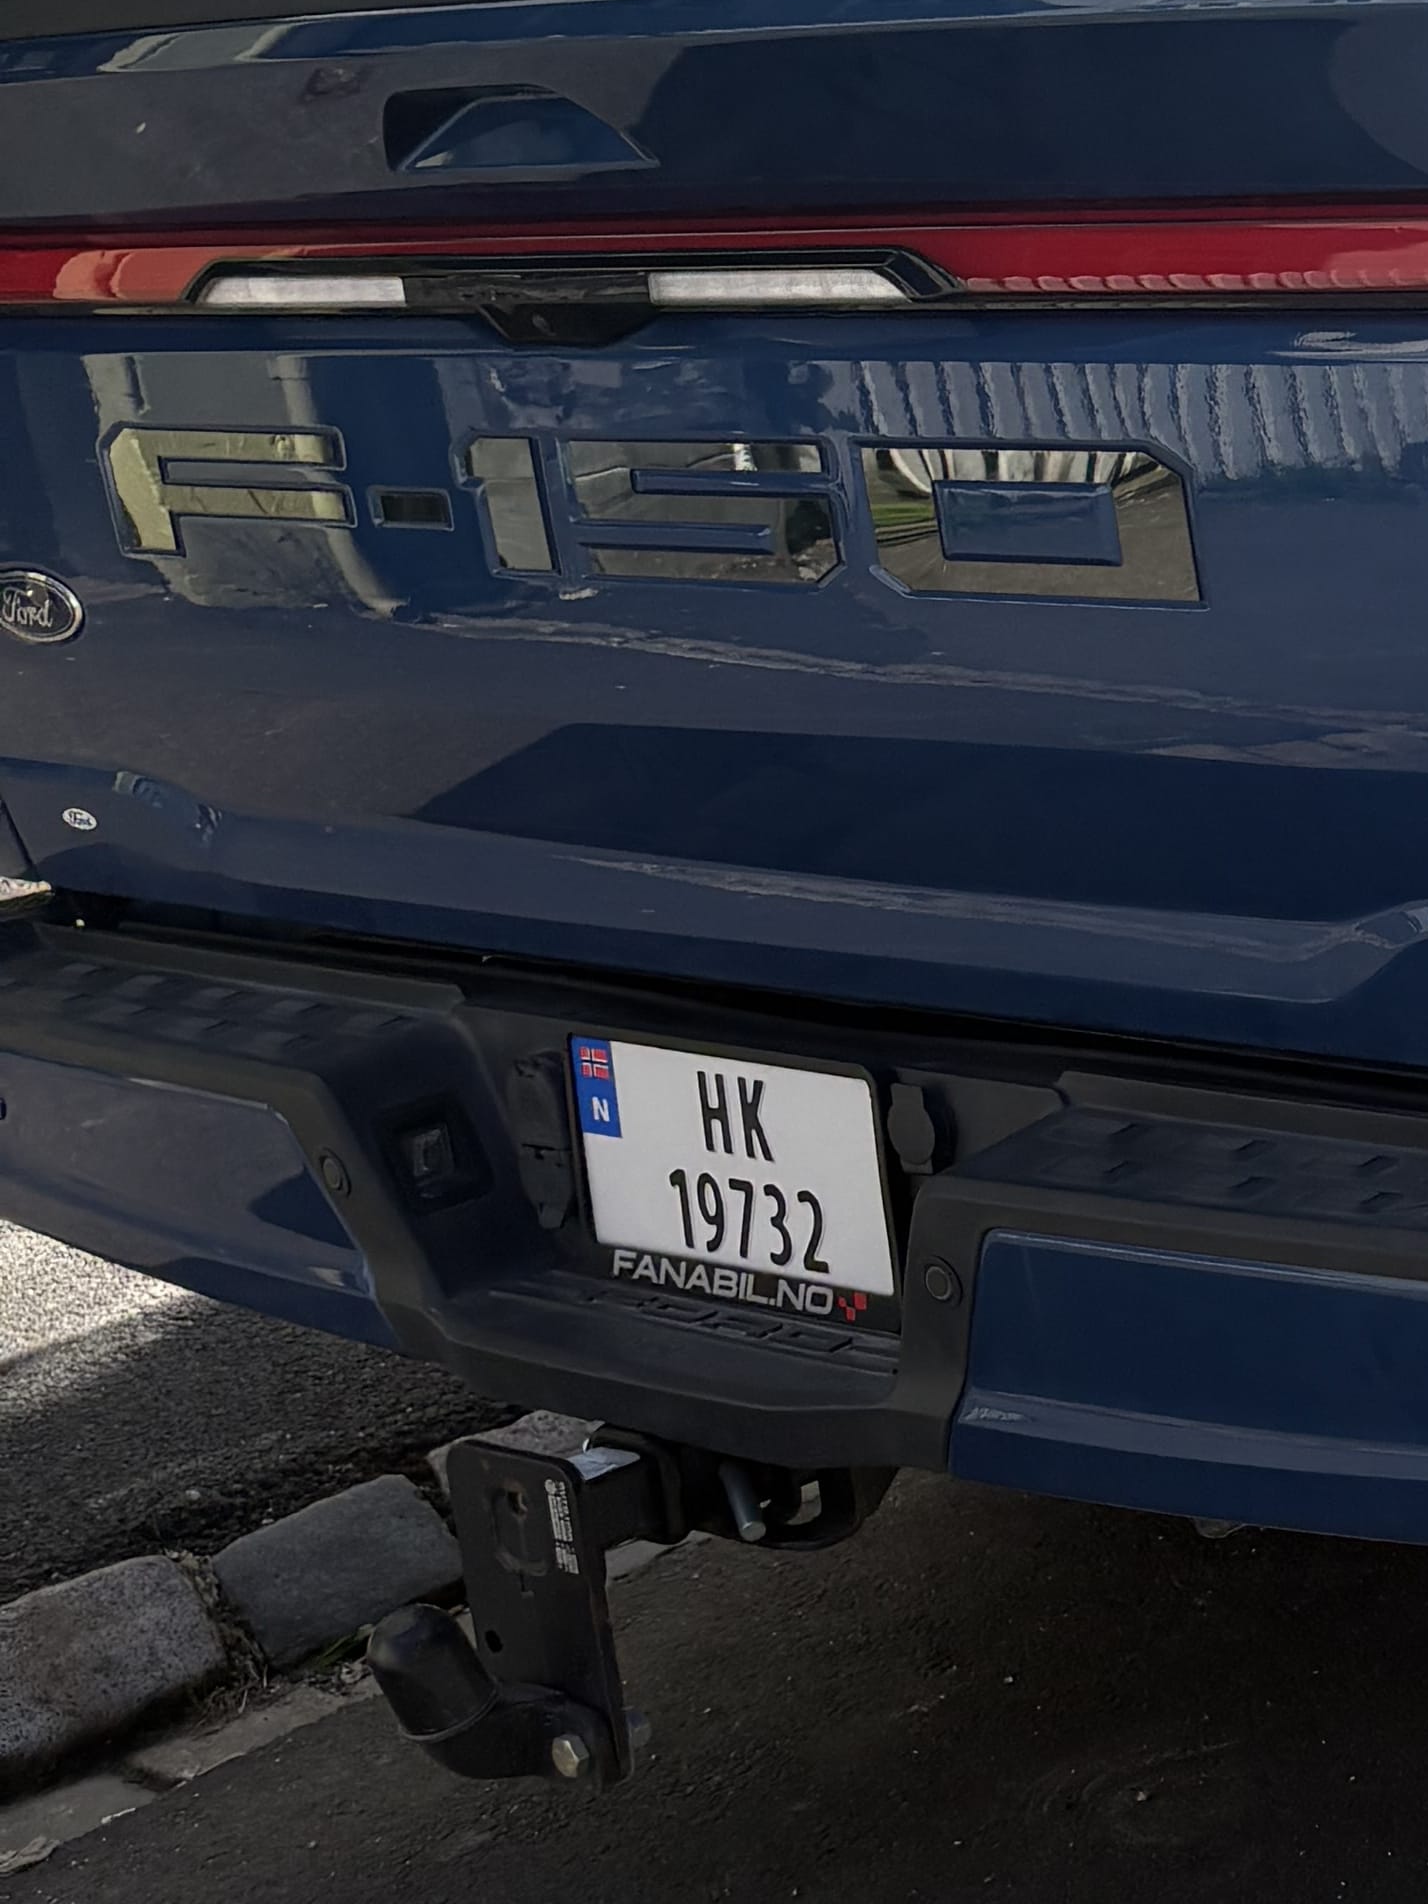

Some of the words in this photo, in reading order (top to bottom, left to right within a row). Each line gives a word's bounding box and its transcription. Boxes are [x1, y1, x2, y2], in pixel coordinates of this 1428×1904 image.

[101, 424, 1209, 612] F-150
[2, 586, 53, 628] Ford
[592, 1097, 610, 1122] N
[697, 1070, 775, 1161] HK
[669, 1168, 830, 1274] 19732
[612, 1249, 834, 1315] FANABIL.NO
